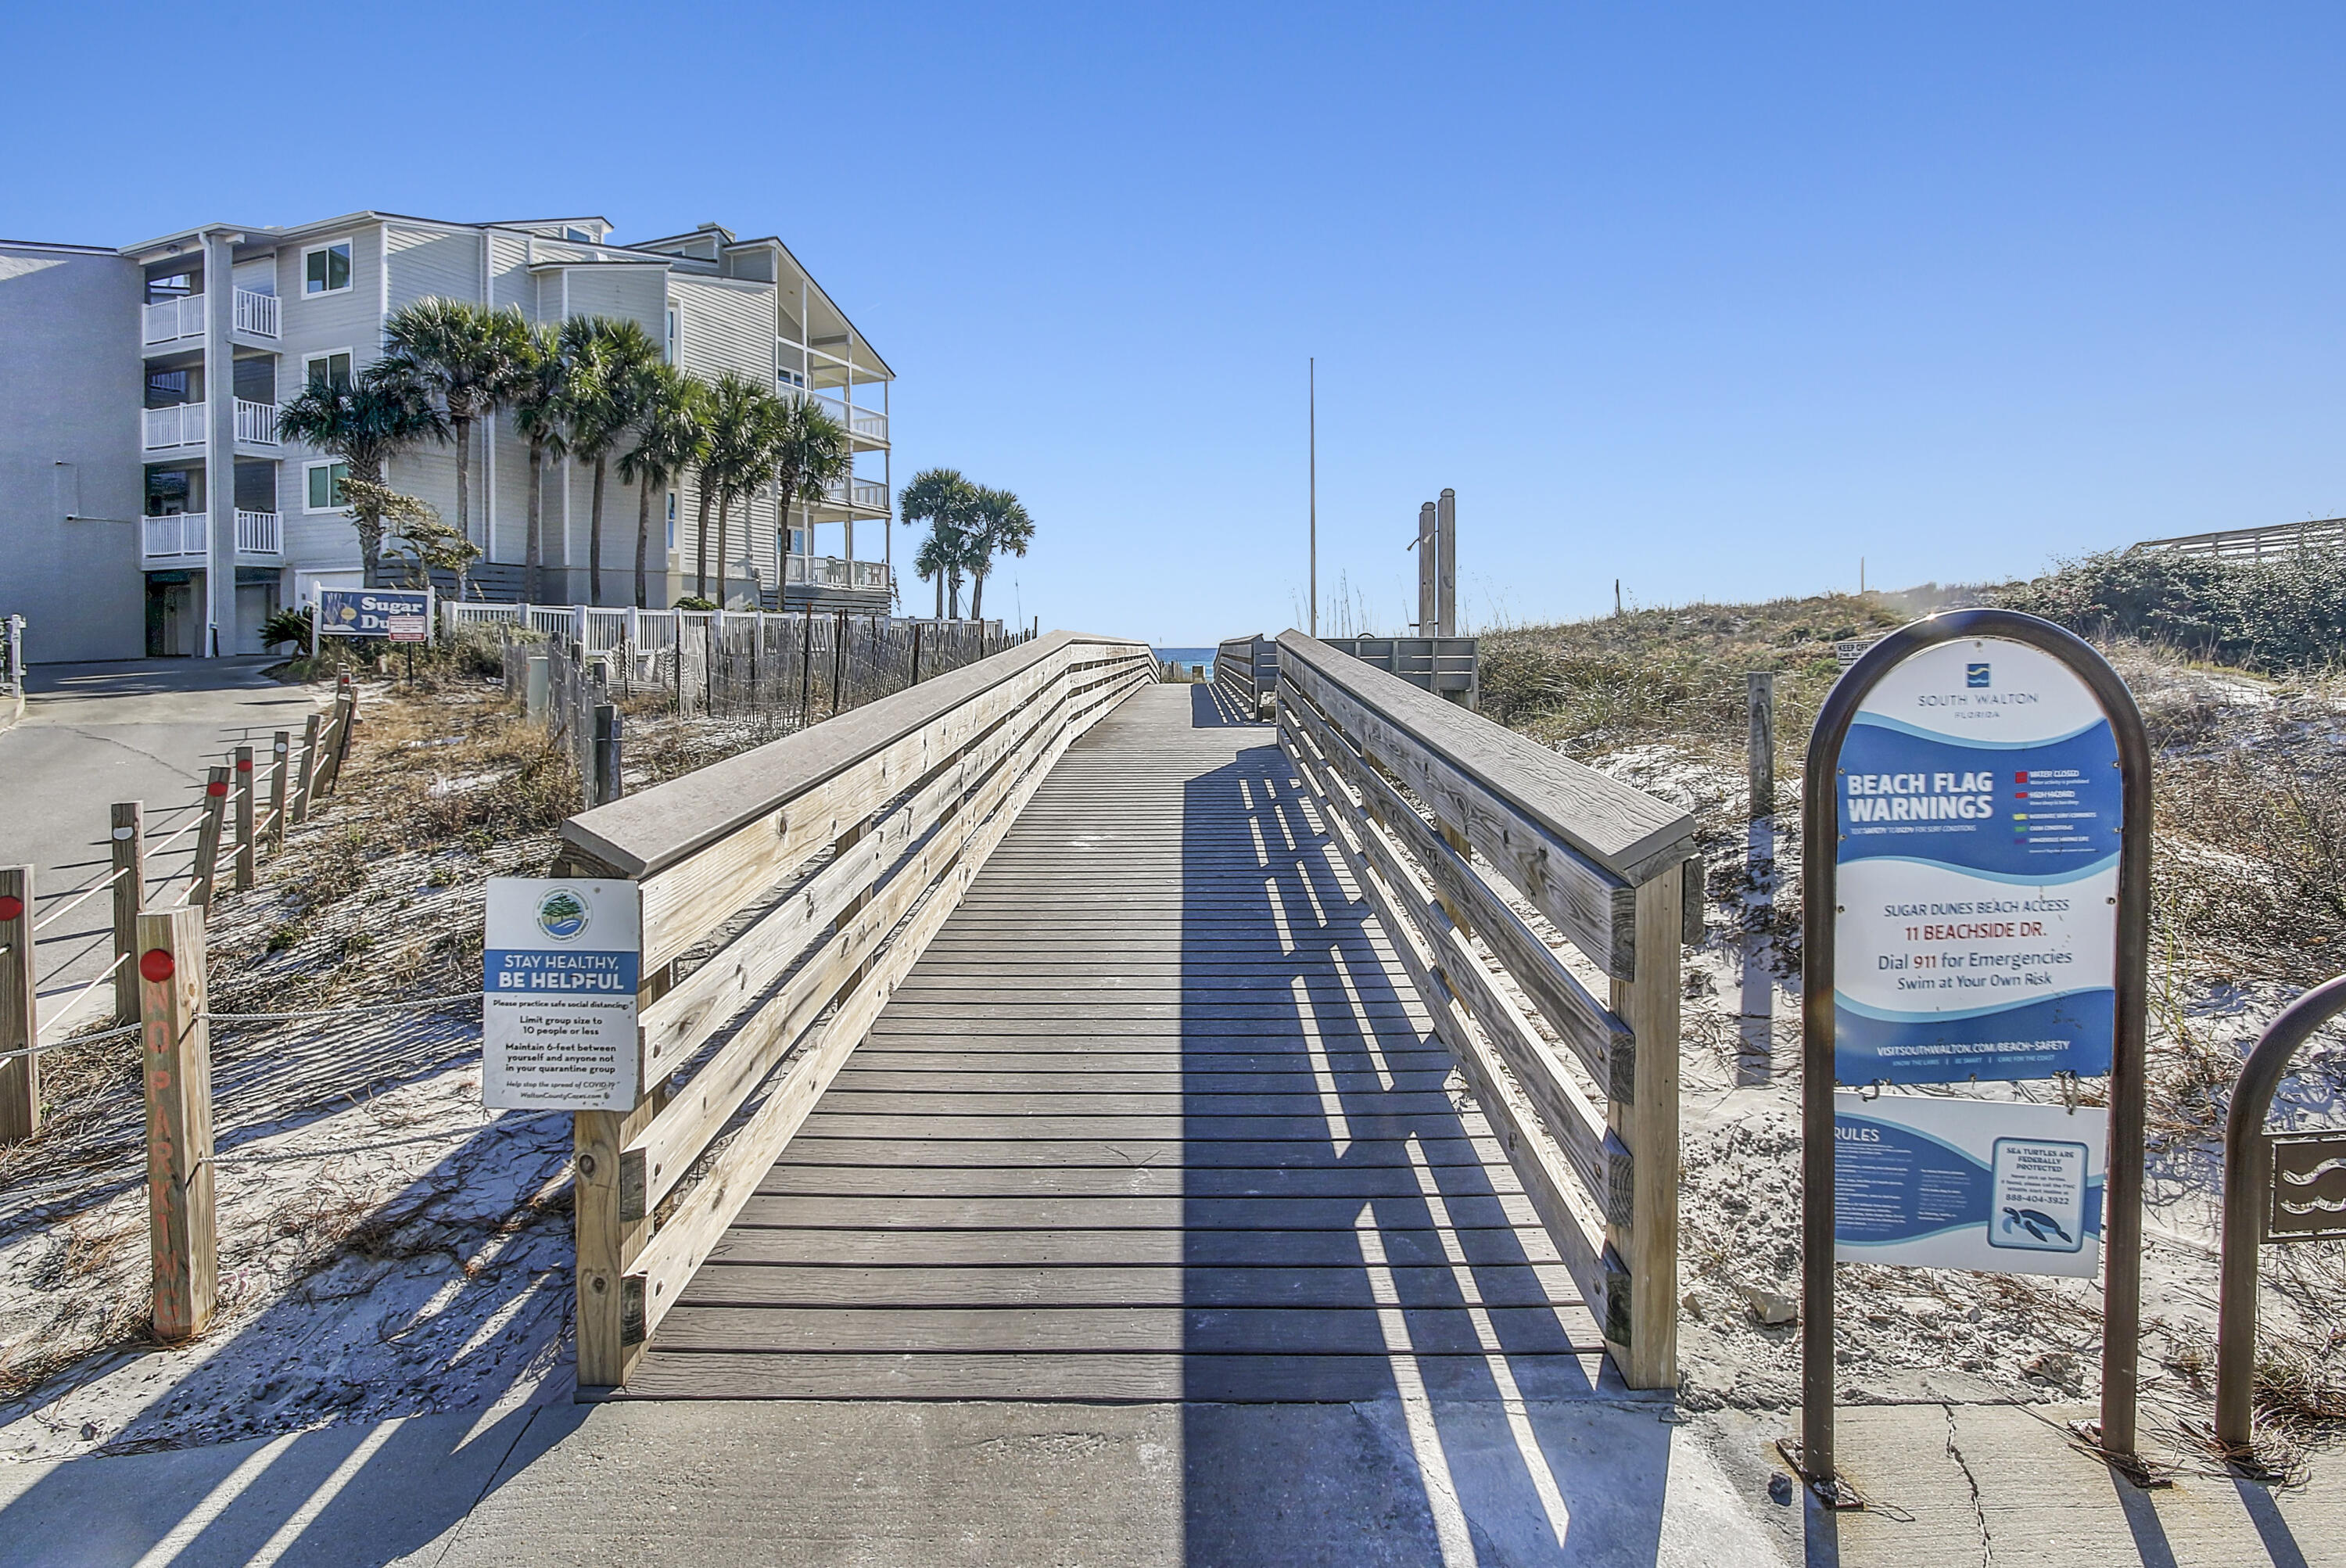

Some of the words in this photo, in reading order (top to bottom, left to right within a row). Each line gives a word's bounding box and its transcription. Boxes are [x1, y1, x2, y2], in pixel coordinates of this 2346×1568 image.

[361, 597, 423, 615] Sugar
[361, 615, 389, 630] Du
[1917, 695, 1968, 706] SOUTH
[1975, 693, 2039, 705] WALTON
[1847, 773, 1926, 795] BEACH
[1933, 771, 1993, 793] FLAG
[1847, 795, 1993, 822] WARNINGS
[1884, 904, 1928, 917] SUGAR
[1931, 902, 1974, 915] DUNES
[1977, 900, 2019, 913] BEACH
[2022, 899, 2071, 913] ACCESS
[1905, 927, 1919, 941] 11
[1923, 922, 2015, 939] BEACHSIDE
[2019, 921, 2048, 937] DR.
[504, 955, 541, 968] STAY
[545, 955, 619, 971] HEALTHY,
[1878, 953, 1908, 971] Dial
[1914, 954, 1937, 970] 911
[1941, 952, 1965, 968] for
[1968, 949, 2073, 971] Emergencies
[498, 971, 526, 989] BE
[531, 971, 624, 990] HELPFUL
[1897, 976, 1935, 990] Swim
[1939, 977, 1953, 989] at
[1956, 974, 1987, 988] Your
[1990, 973, 2021, 986] Own
[2024, 971, 2054, 985] Risk
[518, 999, 548, 1009] practice
[536, 1026, 567, 1035] people
[1876, 1040, 2072, 1057] VISITSOUTHWALTON.COM/BEACH-SAFETY
[507, 1053, 544, 1062] yourself
[539, 1064, 587, 1073] quarantine
[1834, 1127, 1881, 1142] RULES
[2018, 1156, 2062, 1164] FEDERALLY
[2023, 1148, 2057, 1157] TURTLES
[2017, 1164, 2063, 1172] PROTECTED
[2005, 1193, 2070, 1205] 888-404-3922
